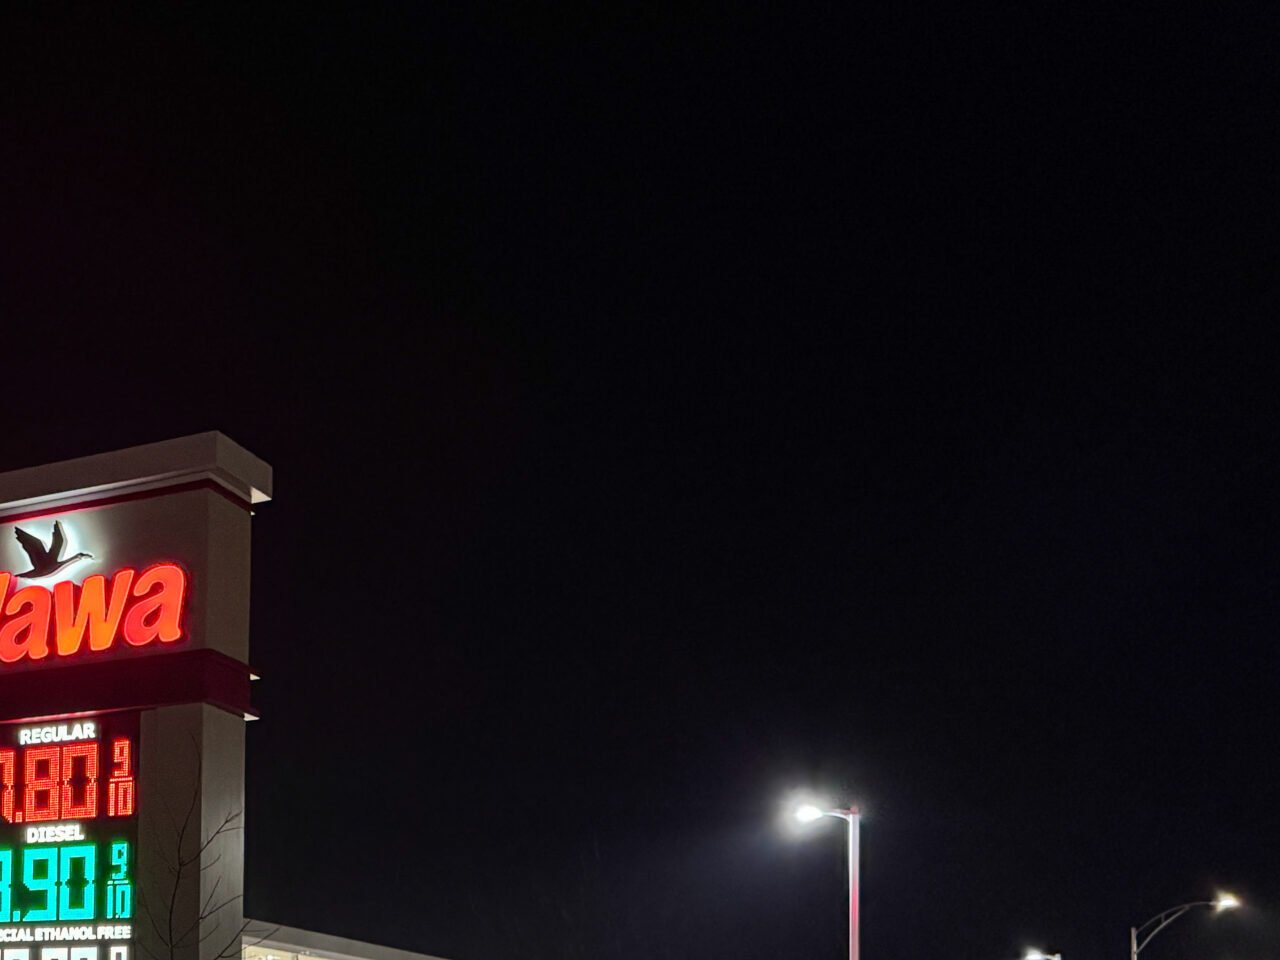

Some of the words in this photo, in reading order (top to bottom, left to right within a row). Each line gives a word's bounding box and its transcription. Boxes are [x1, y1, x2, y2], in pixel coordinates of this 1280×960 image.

[20, 722, 96, 745] REGULAR
[26, 825, 85, 843] DIESEL
[35, 926, 96, 941] ETHANOL
[97, 925, 132, 939] FREE
